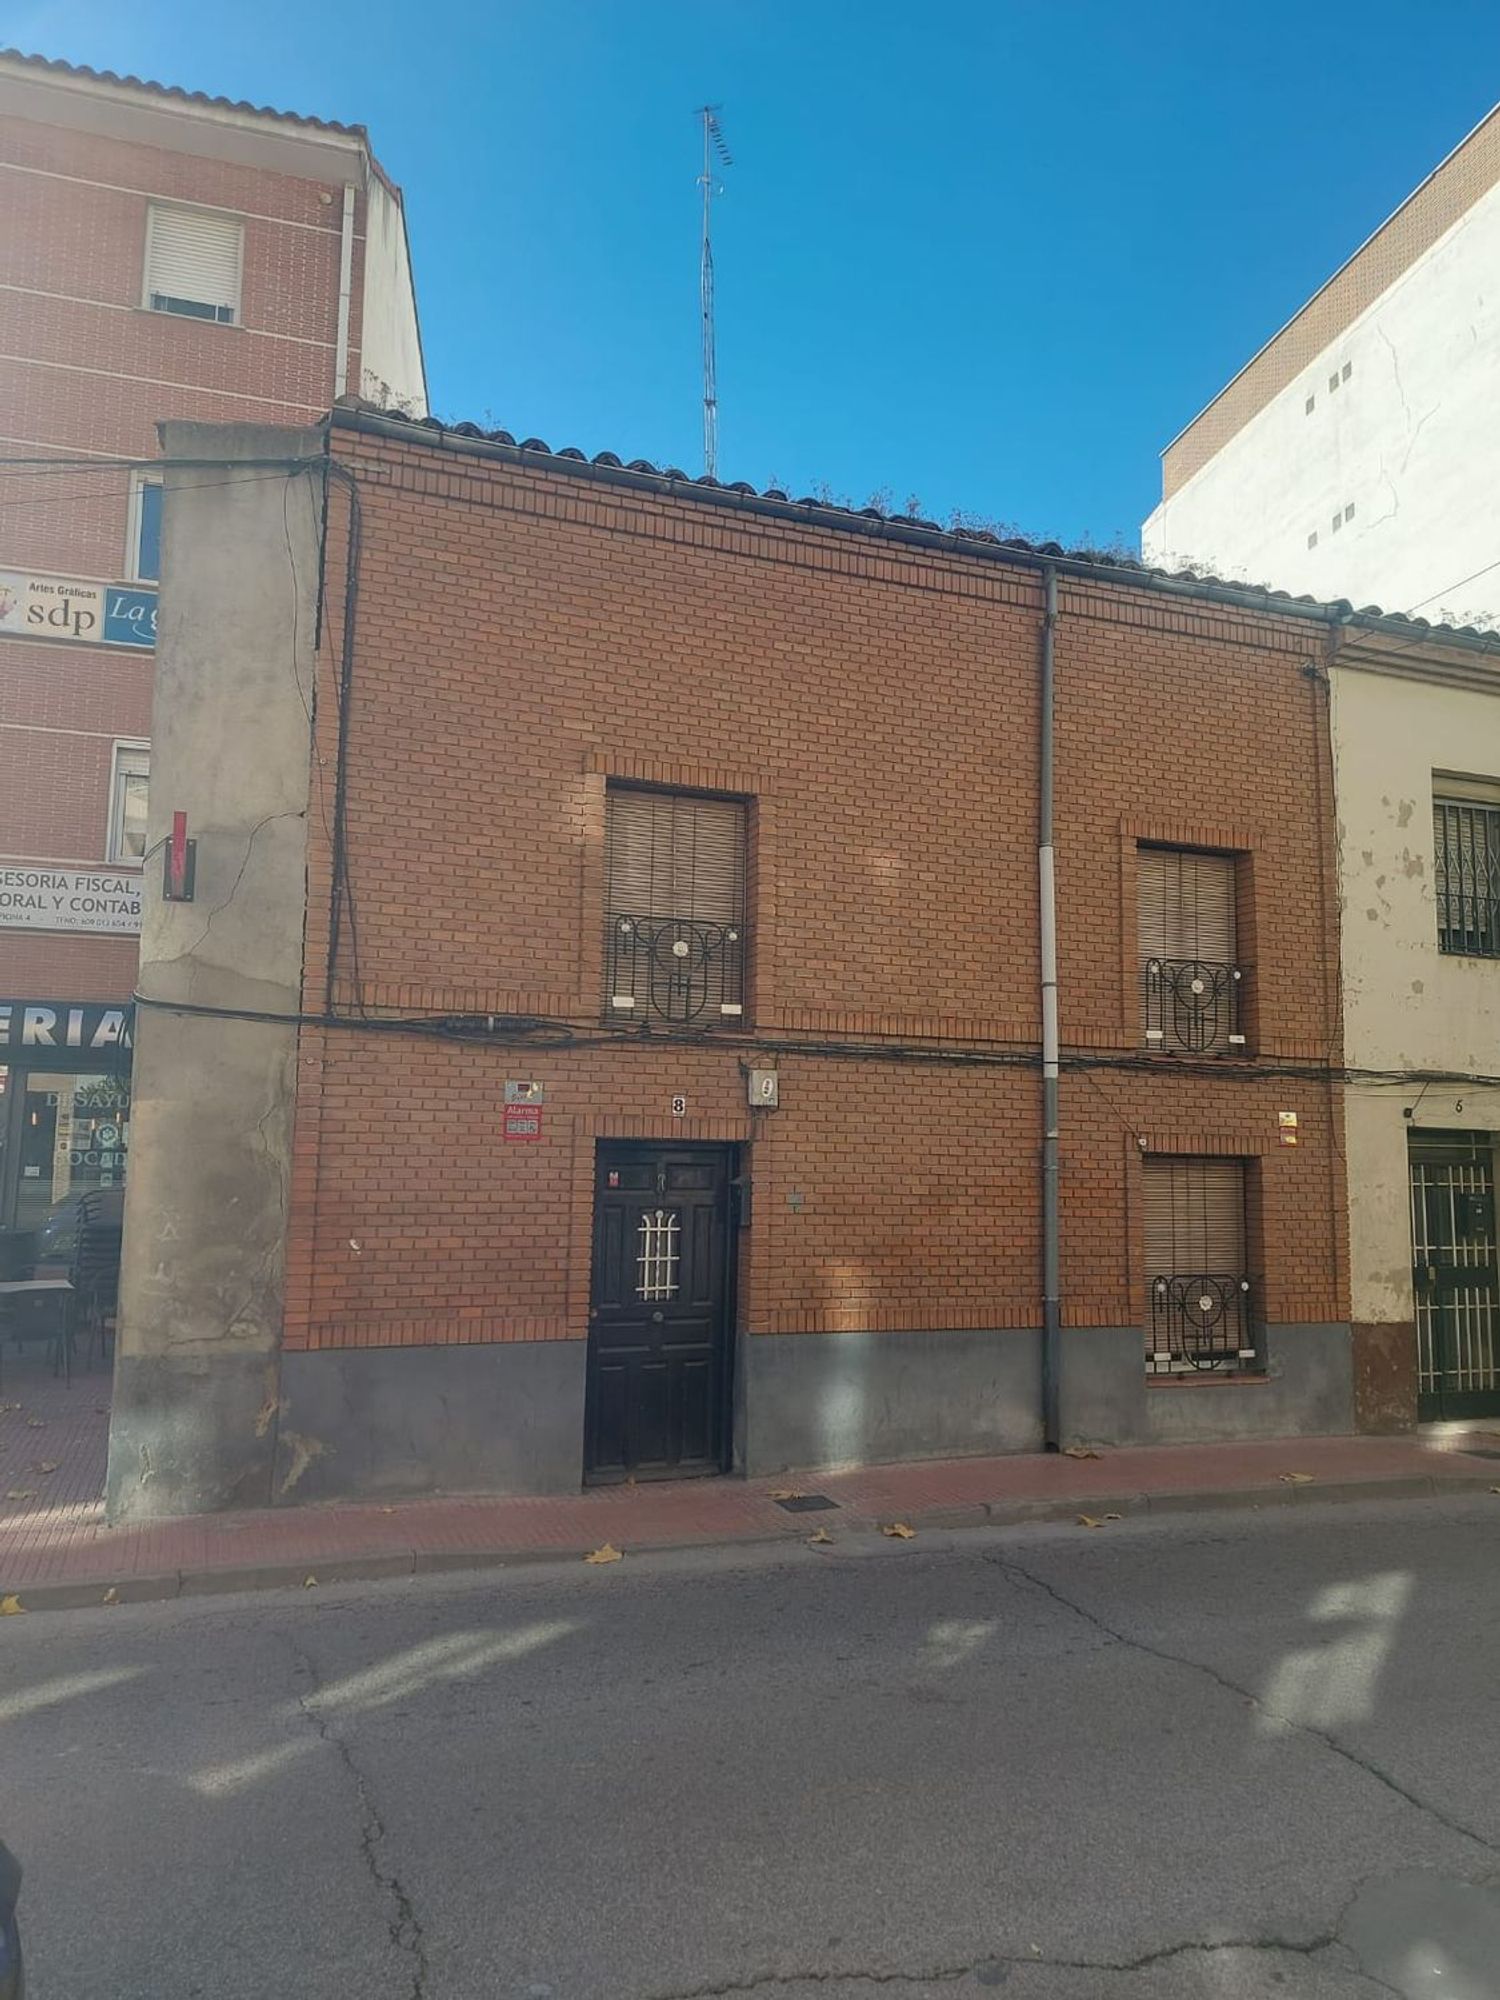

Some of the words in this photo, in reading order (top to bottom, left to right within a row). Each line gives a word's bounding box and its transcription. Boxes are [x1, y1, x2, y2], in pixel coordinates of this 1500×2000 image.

[29, 582, 55, 595] Artes
[57, 584, 97, 599] Gráficas
[27, 599, 95, 636] sdp
[110, 597, 145, 621] La
[75, 877, 140, 897] FISCAL,
[0, 892, 47, 909] ORAL
[53, 896, 64, 910] Y
[70, 897, 140, 915] CONTAB
[46, 1093, 129, 1108] DSAYU
[673, 1098, 684, 1112] 8
[1455, 1099, 1464, 1113] 6
[58, 1151, 126, 1166] OCAD
